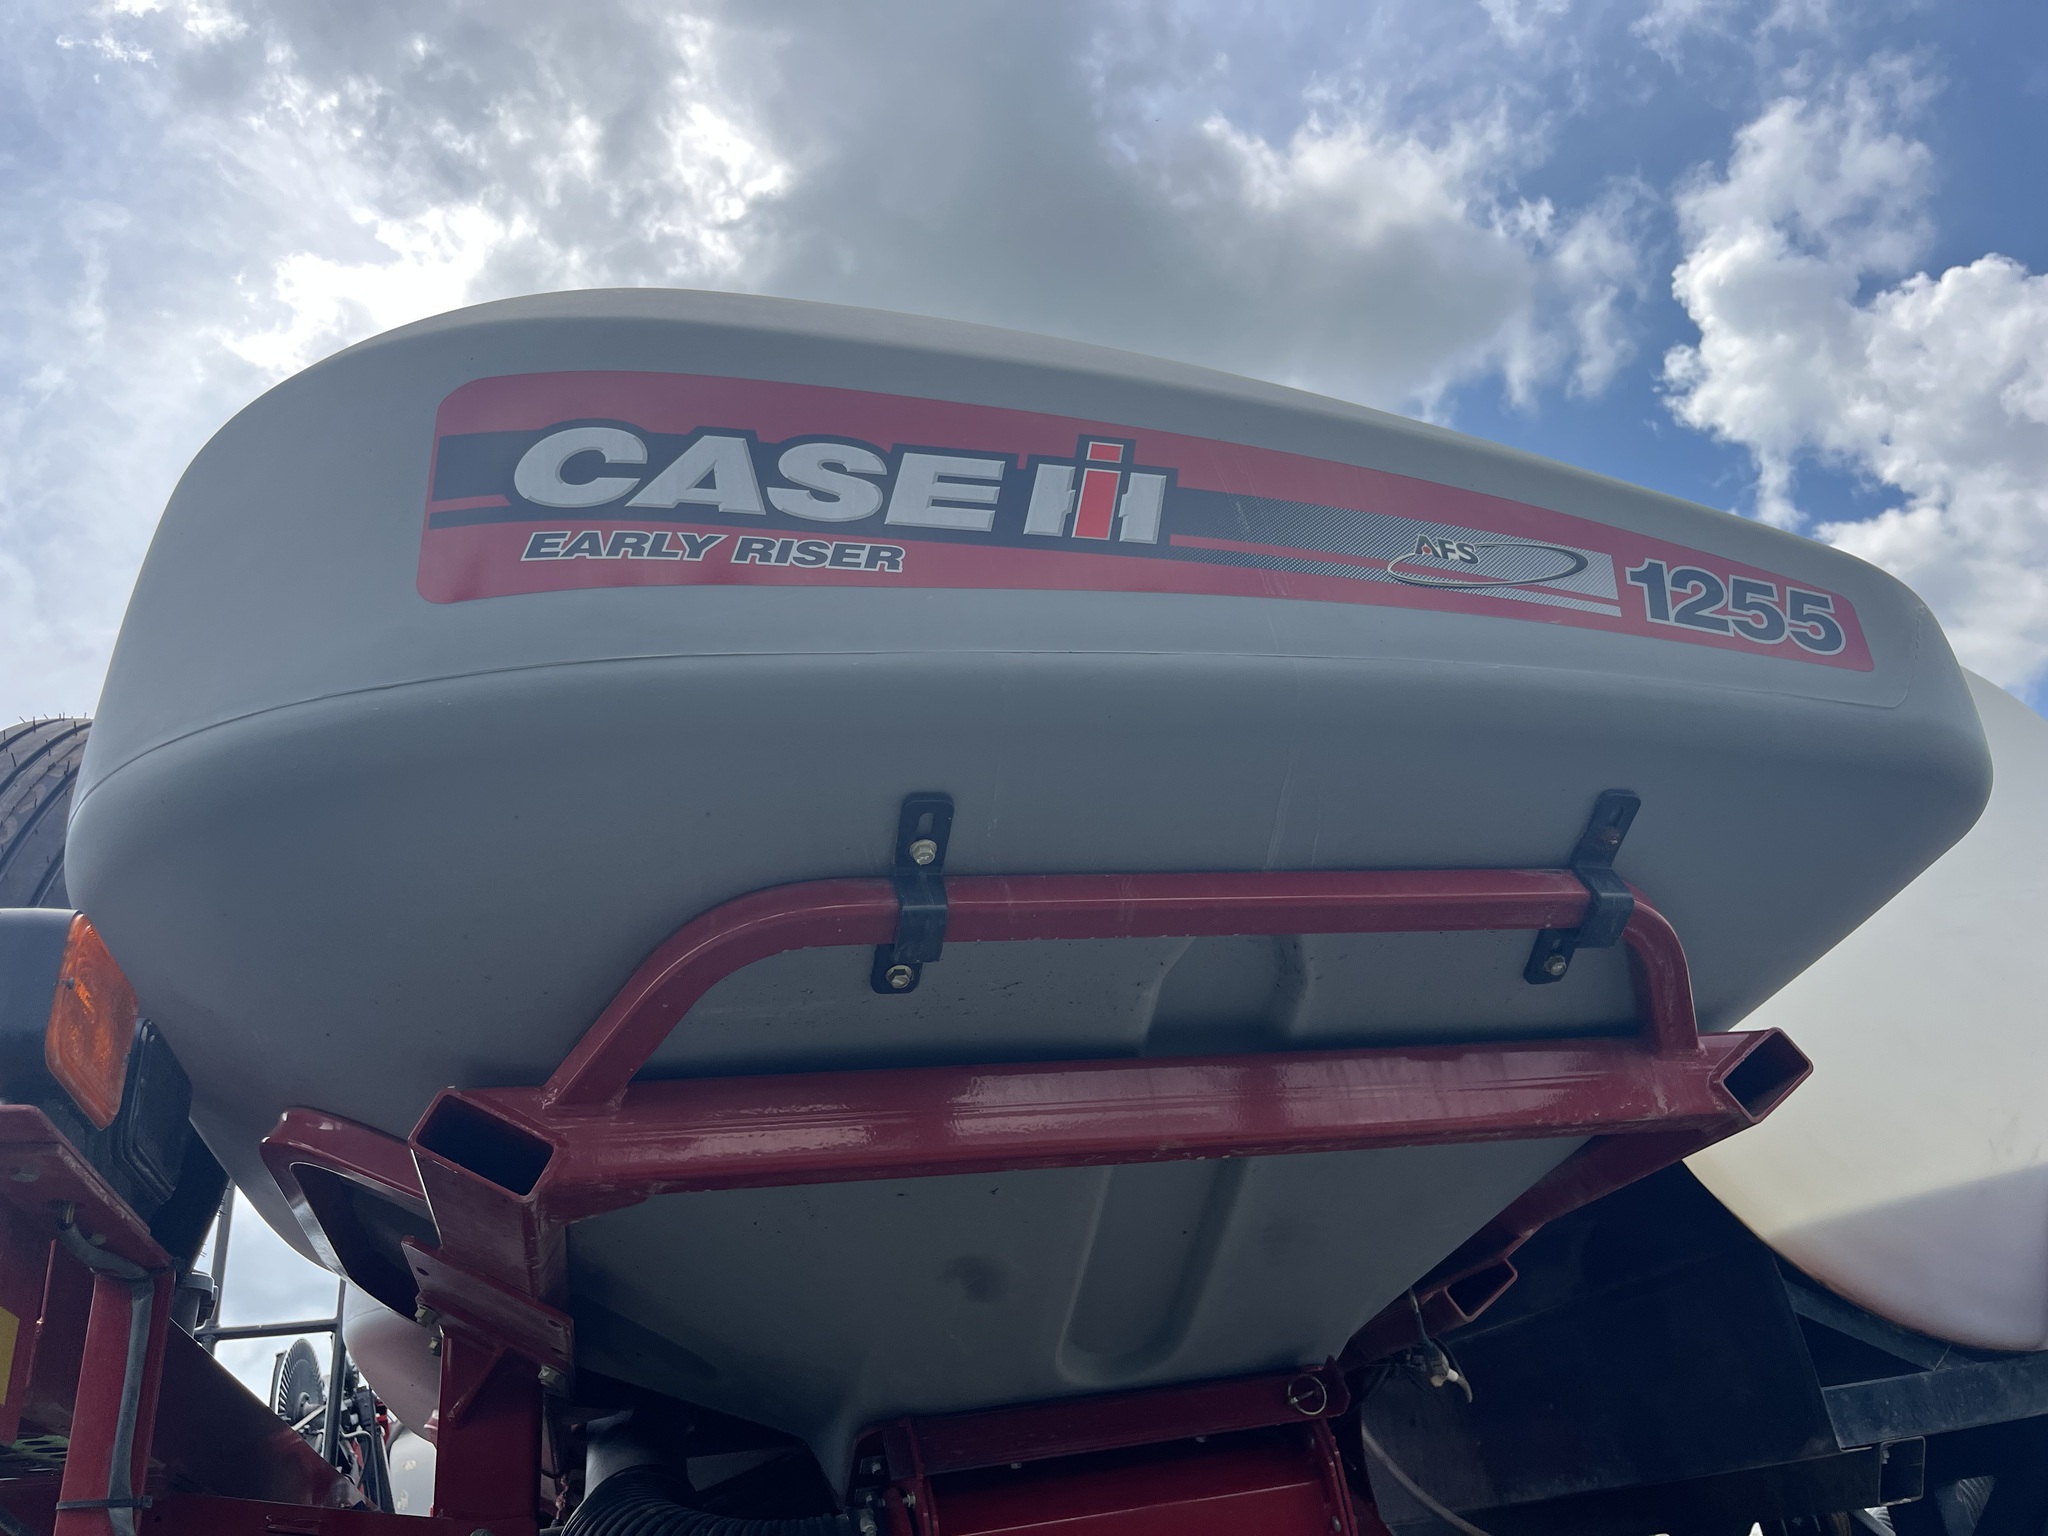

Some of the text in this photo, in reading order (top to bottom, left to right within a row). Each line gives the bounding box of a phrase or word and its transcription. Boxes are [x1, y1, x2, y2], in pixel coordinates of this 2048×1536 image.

[513, 426, 1006, 533] CASE
[520, 531, 906, 573] EARLY RISER
[1414, 535, 1480, 565] AFS
[1625, 557, 1847, 656] 1255
